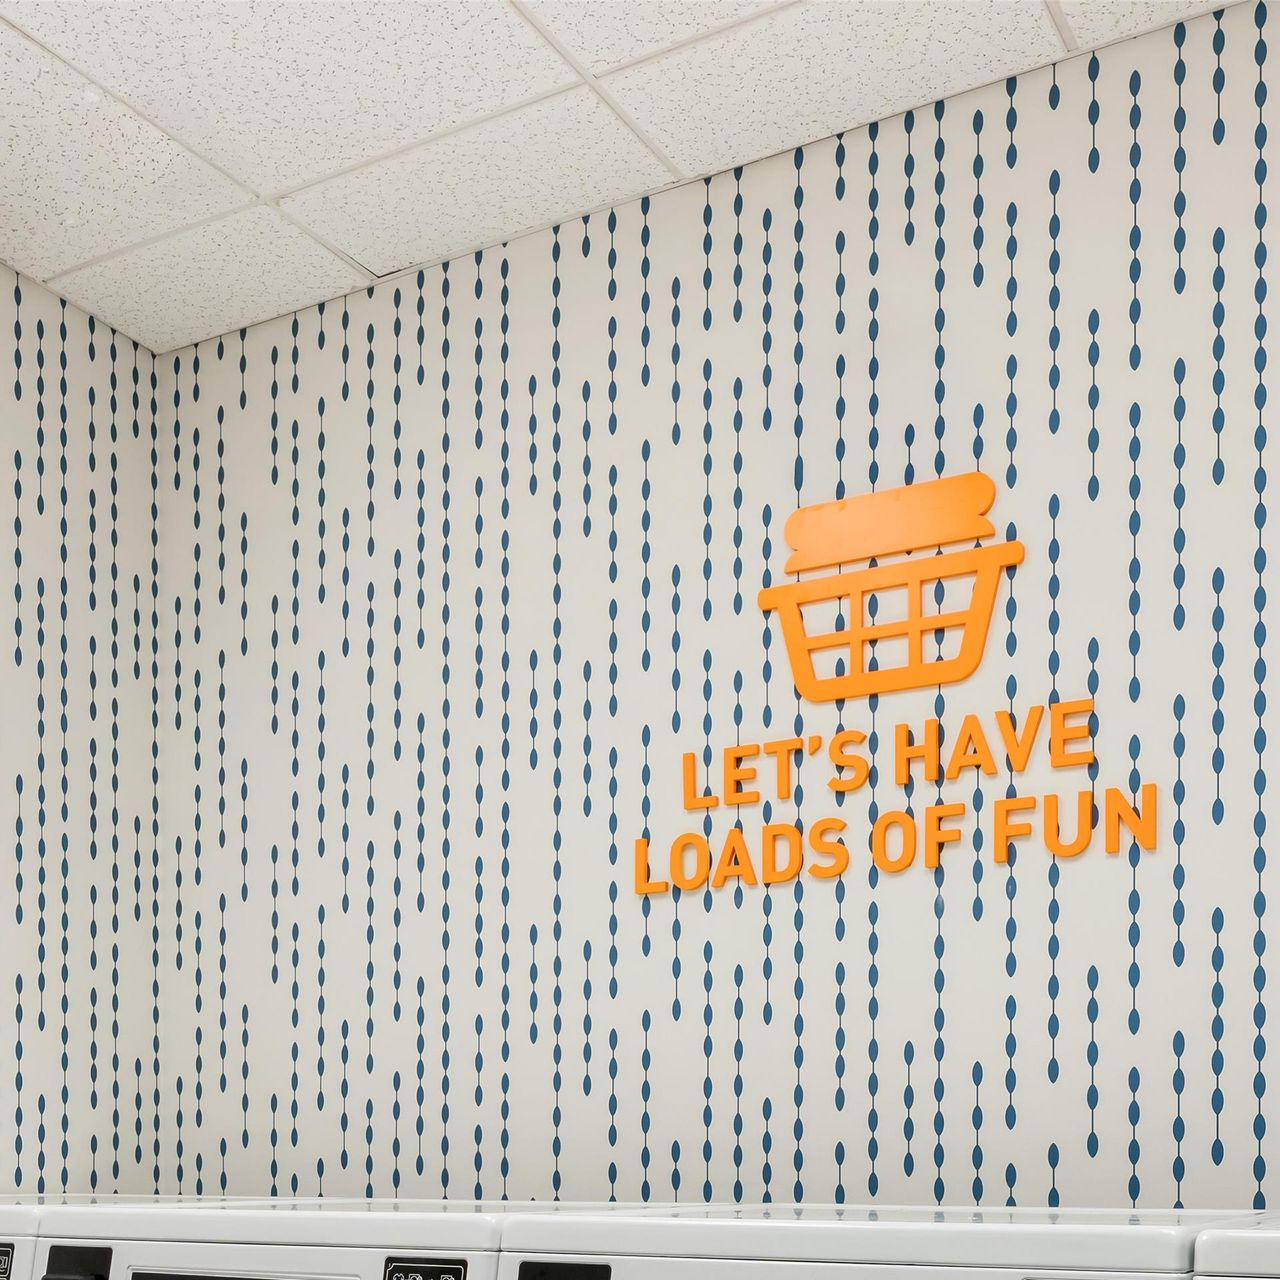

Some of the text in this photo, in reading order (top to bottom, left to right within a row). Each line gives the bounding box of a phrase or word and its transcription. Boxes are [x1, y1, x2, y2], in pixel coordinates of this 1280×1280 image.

[682, 698, 1095, 810] LET'S HAVE
[634, 783, 1157, 894] LOADS OF FUN
